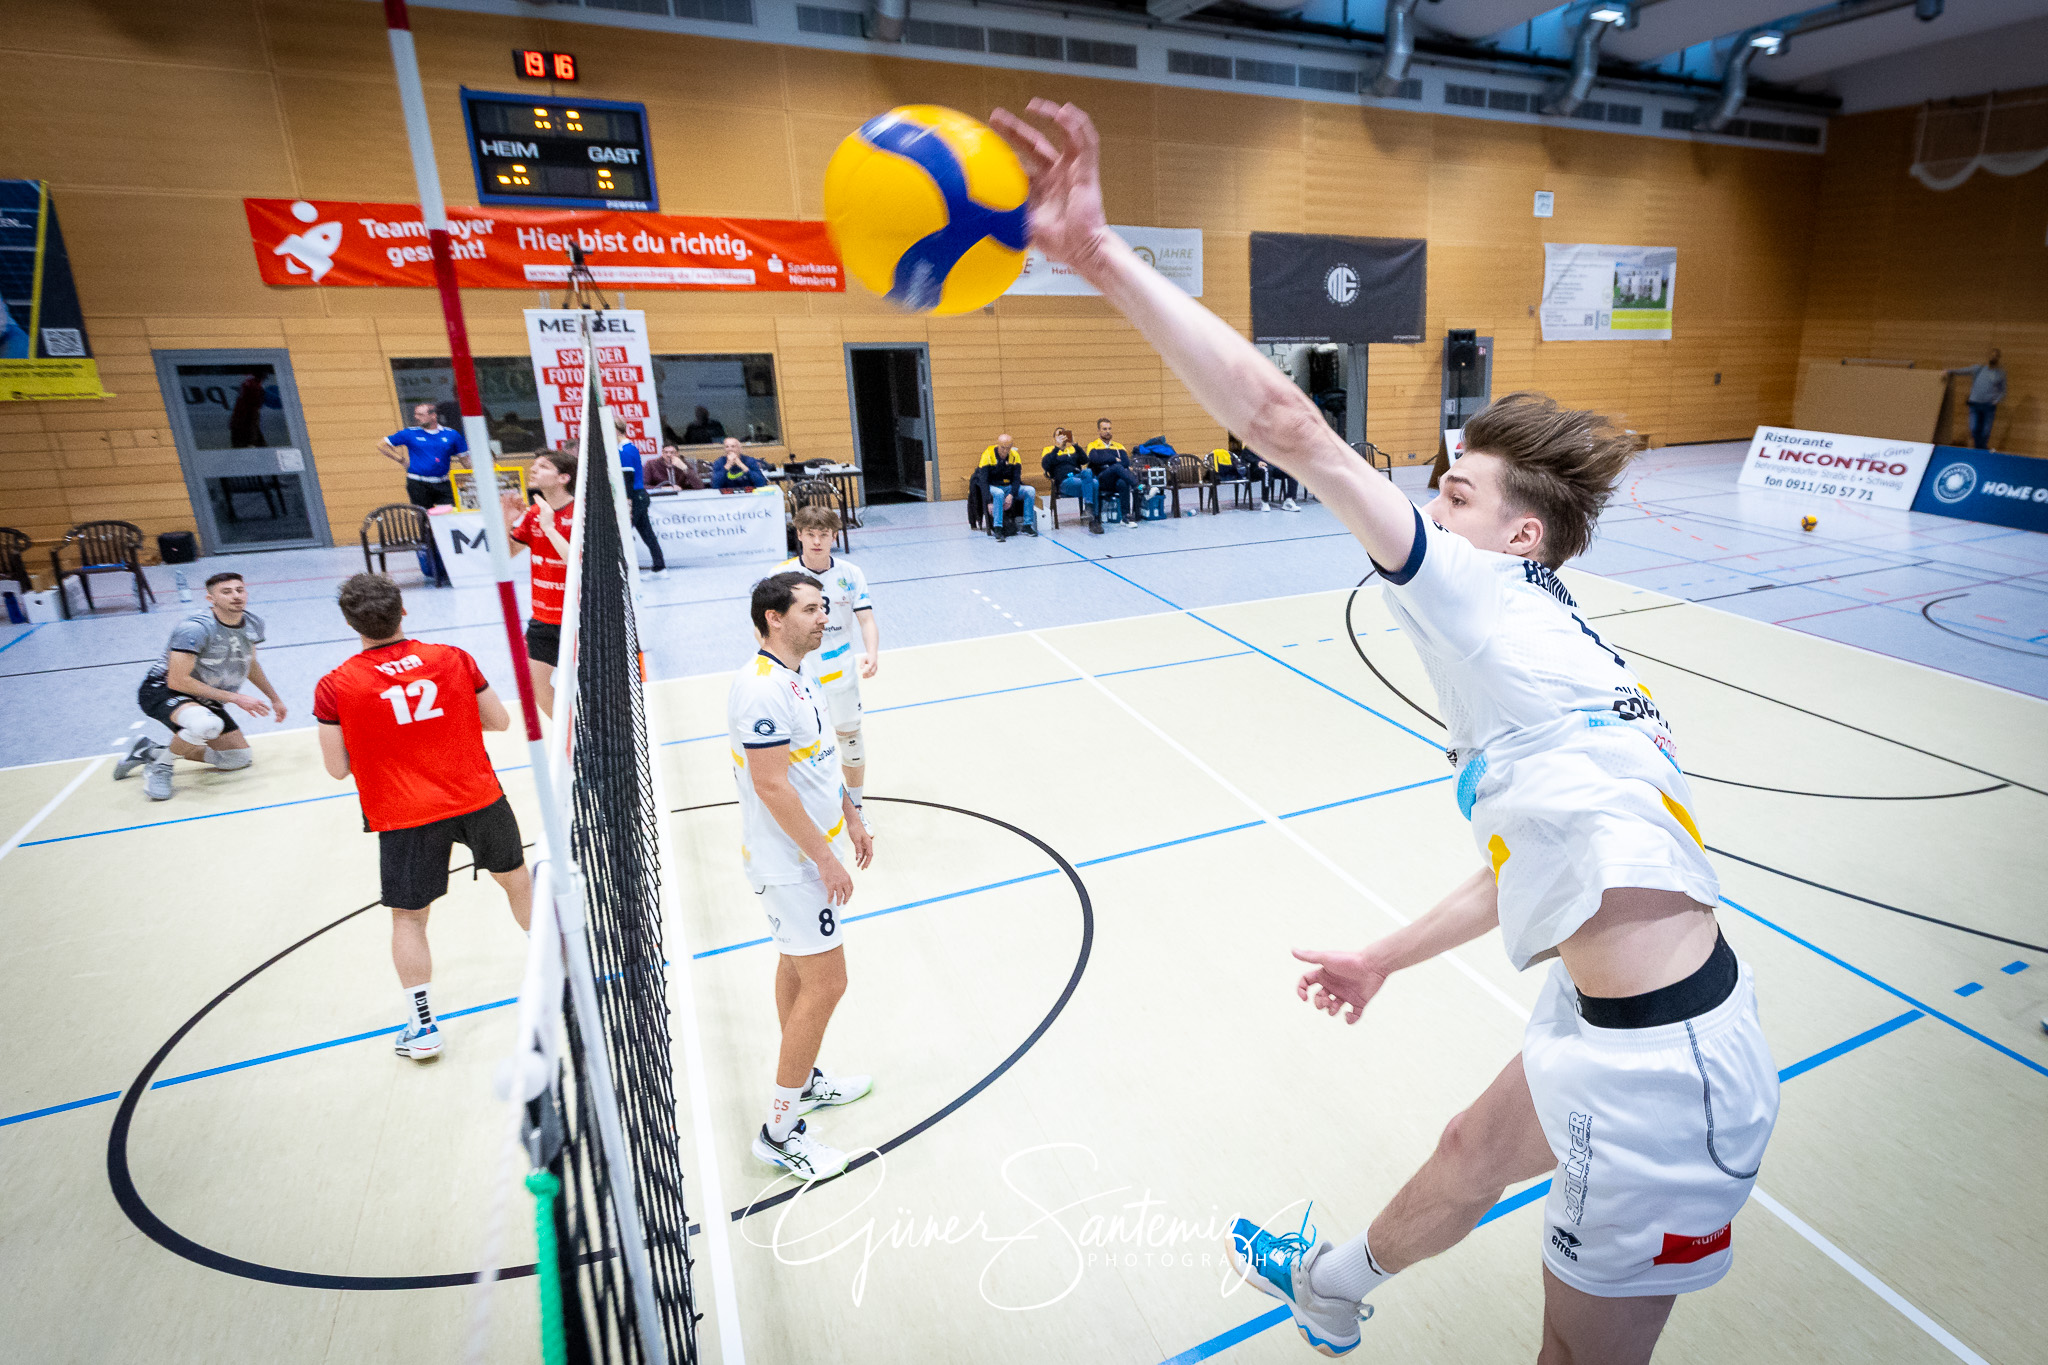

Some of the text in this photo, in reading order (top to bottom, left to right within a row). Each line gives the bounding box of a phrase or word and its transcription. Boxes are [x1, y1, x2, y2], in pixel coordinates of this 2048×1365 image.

[523, 50, 575, 80] 19 16
[480, 139, 641, 165] HEIM GAST
[358, 218, 495, 240] Teamayer
[386, 239, 487, 268] gesht!
[516, 227, 753, 261] Hier bist du richtig.
[787, 261, 838, 275] Sparkasse
[788, 274, 837, 288] Nürnberg
[539, 318, 636, 333] MEEL
[560, 347, 624, 366] SCHDER
[548, 366, 639, 384] FOTOPETEN
[564, 386, 634, 402] SCFTEN
[1764, 431, 1834, 449] Ristorante
[1764, 475, 1874, 501] fon 0911/50 57 71
[1981, 480, 2033, 500] HOME
[379, 678, 445, 726] 12
[818, 908, 836, 937] 8
[774, 1098, 790, 1111] CS
